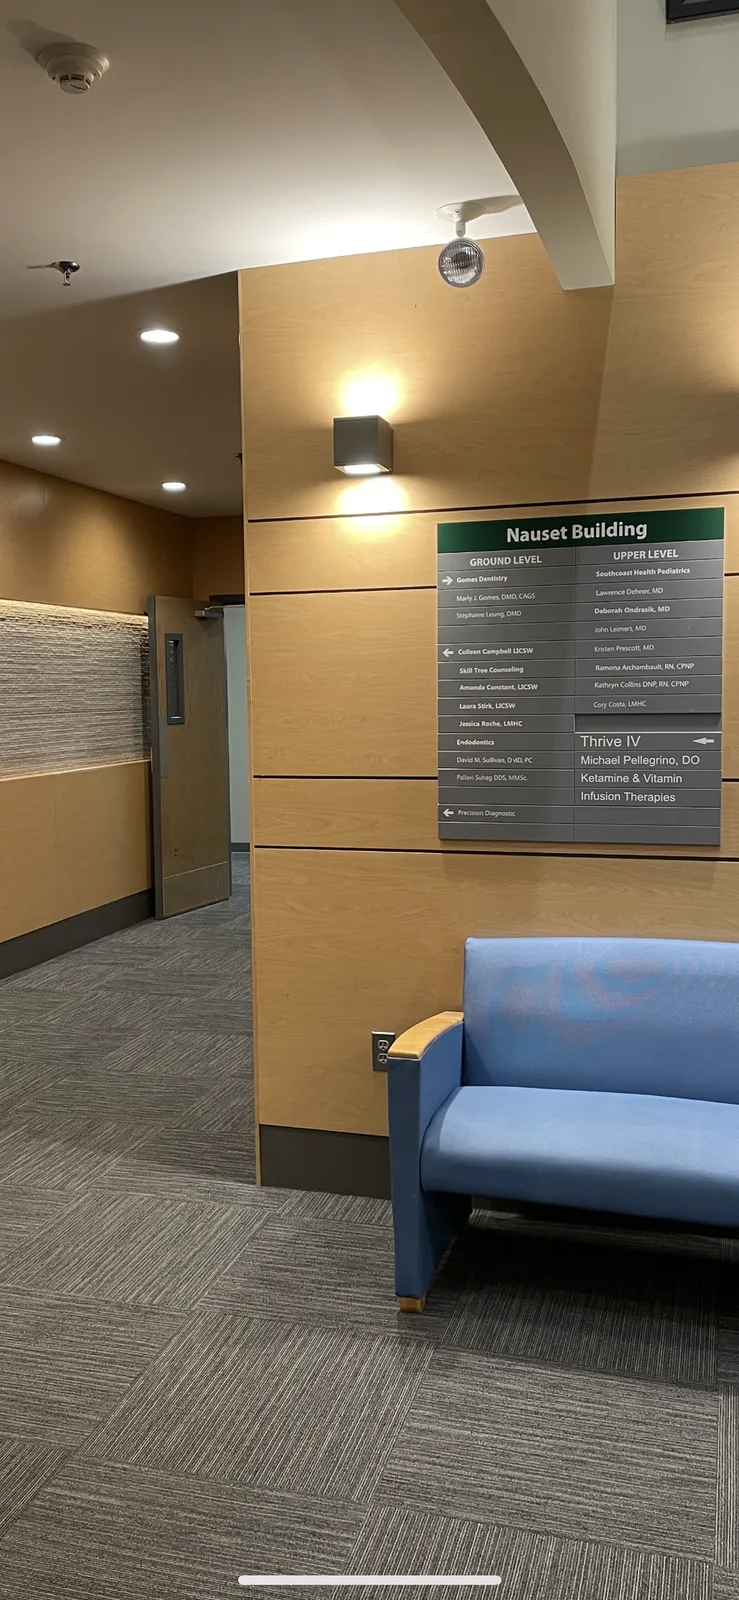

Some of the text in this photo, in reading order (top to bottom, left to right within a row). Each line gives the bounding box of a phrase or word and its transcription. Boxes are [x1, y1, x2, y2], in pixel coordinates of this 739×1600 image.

[506, 521, 648, 542] Nauset Building
[470, 555, 542, 566] GROUND LEVEL
[613, 549, 678, 560] UPPER LEVEL
[580, 735, 641, 747] Thrive IV
[580, 755, 700, 767] Michael Pellegrino, DO
[580, 773, 682, 783] Ketamine & Vitamin
[581, 791, 676, 803] Infusion Therapies
